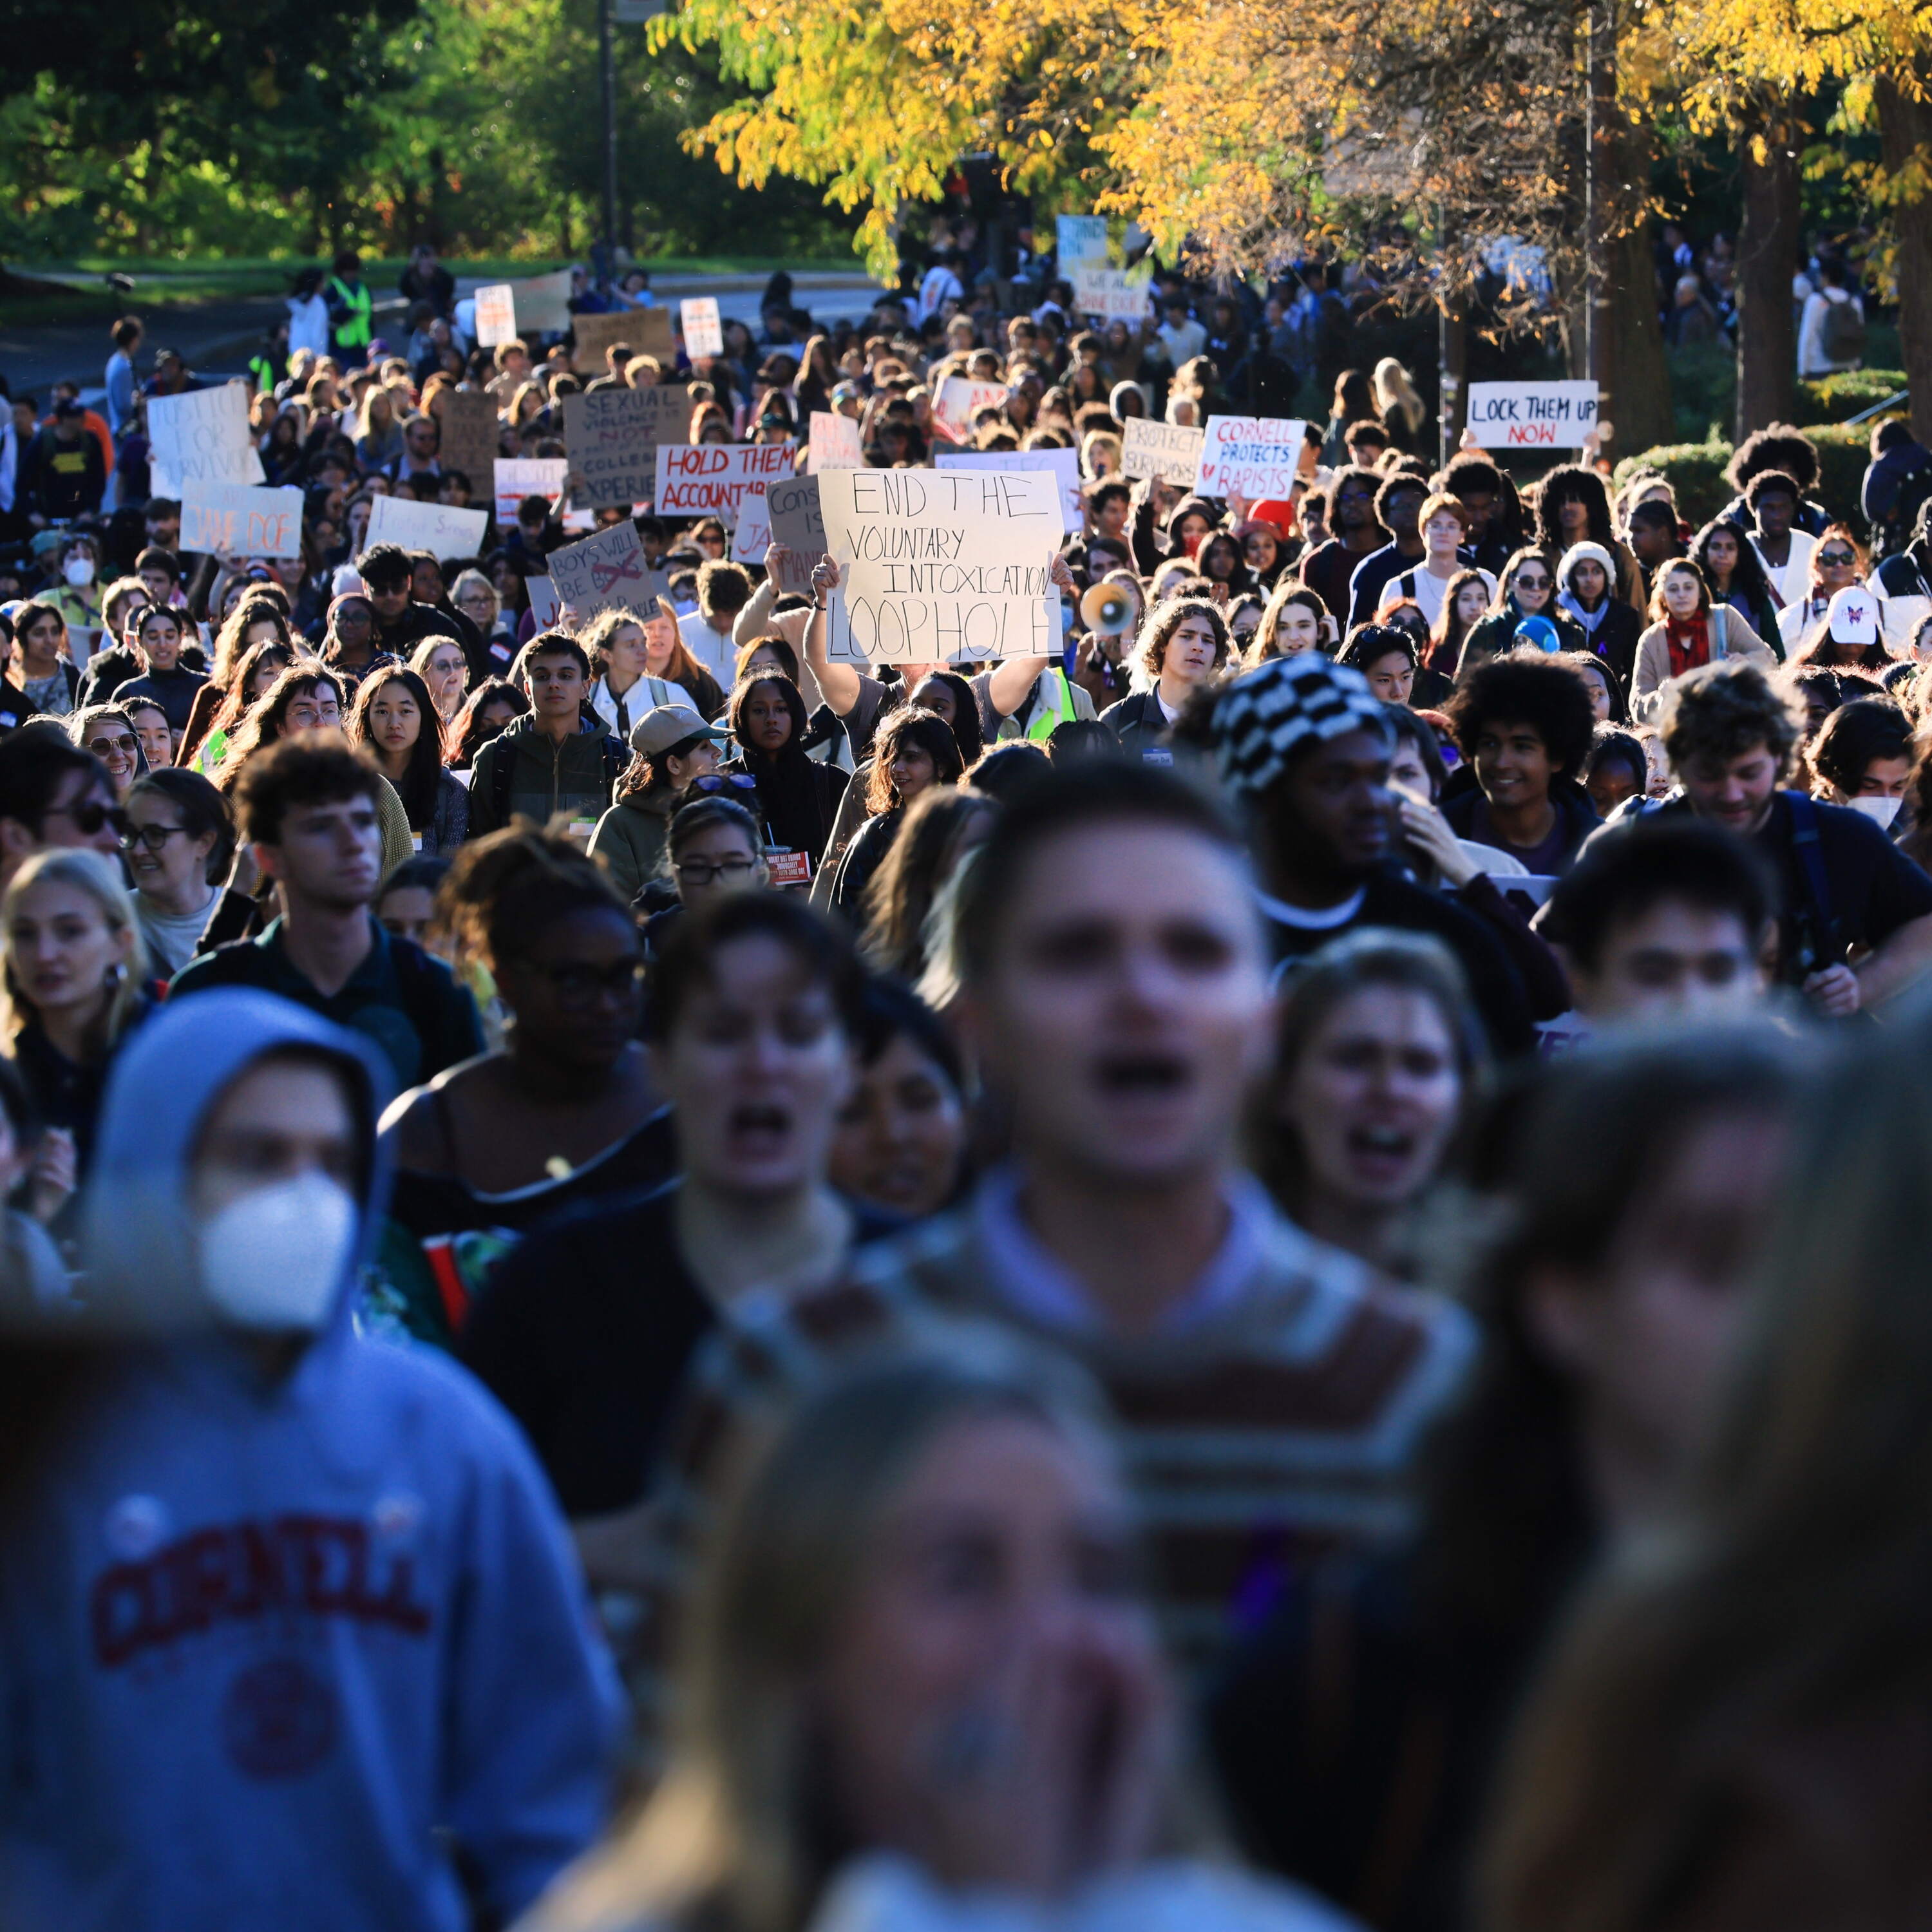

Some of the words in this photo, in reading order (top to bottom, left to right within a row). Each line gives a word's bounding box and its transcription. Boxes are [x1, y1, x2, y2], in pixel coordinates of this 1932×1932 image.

[585, 389, 679, 413] SEXUAL
[1472, 398, 1520, 421] LOCK
[1525, 395, 1570, 421] THEM
[1577, 400, 1597, 421] UP
[599, 425, 655, 442] NOT
[1126, 421, 1200, 451] PROTECT
[1217, 420, 1293, 443] CORNELL
[1508, 422, 1556, 443] NOW
[667, 448, 729, 477] HOLD
[738, 446, 795, 474] THEM
[1220, 442, 1291, 463] PROTECTS
[571, 474, 656, 507] EXPERIE
[853, 473, 926, 517] END
[940, 475, 1048, 517] THE
[1217, 465, 1288, 495] RAPISTS
[662, 481, 770, 511] ACCOUNTAB
[770, 487, 819, 515] Cons
[247, 511, 291, 552] DOE
[846, 526, 965, 561] VOLUNTARY
[552, 547, 600, 578] BOYS
[599, 532, 634, 556] WILL
[562, 577, 587, 603] BE
[882, 562, 1052, 596] INTOXICATION
[829, 596, 1065, 660] LOOPHOLE
